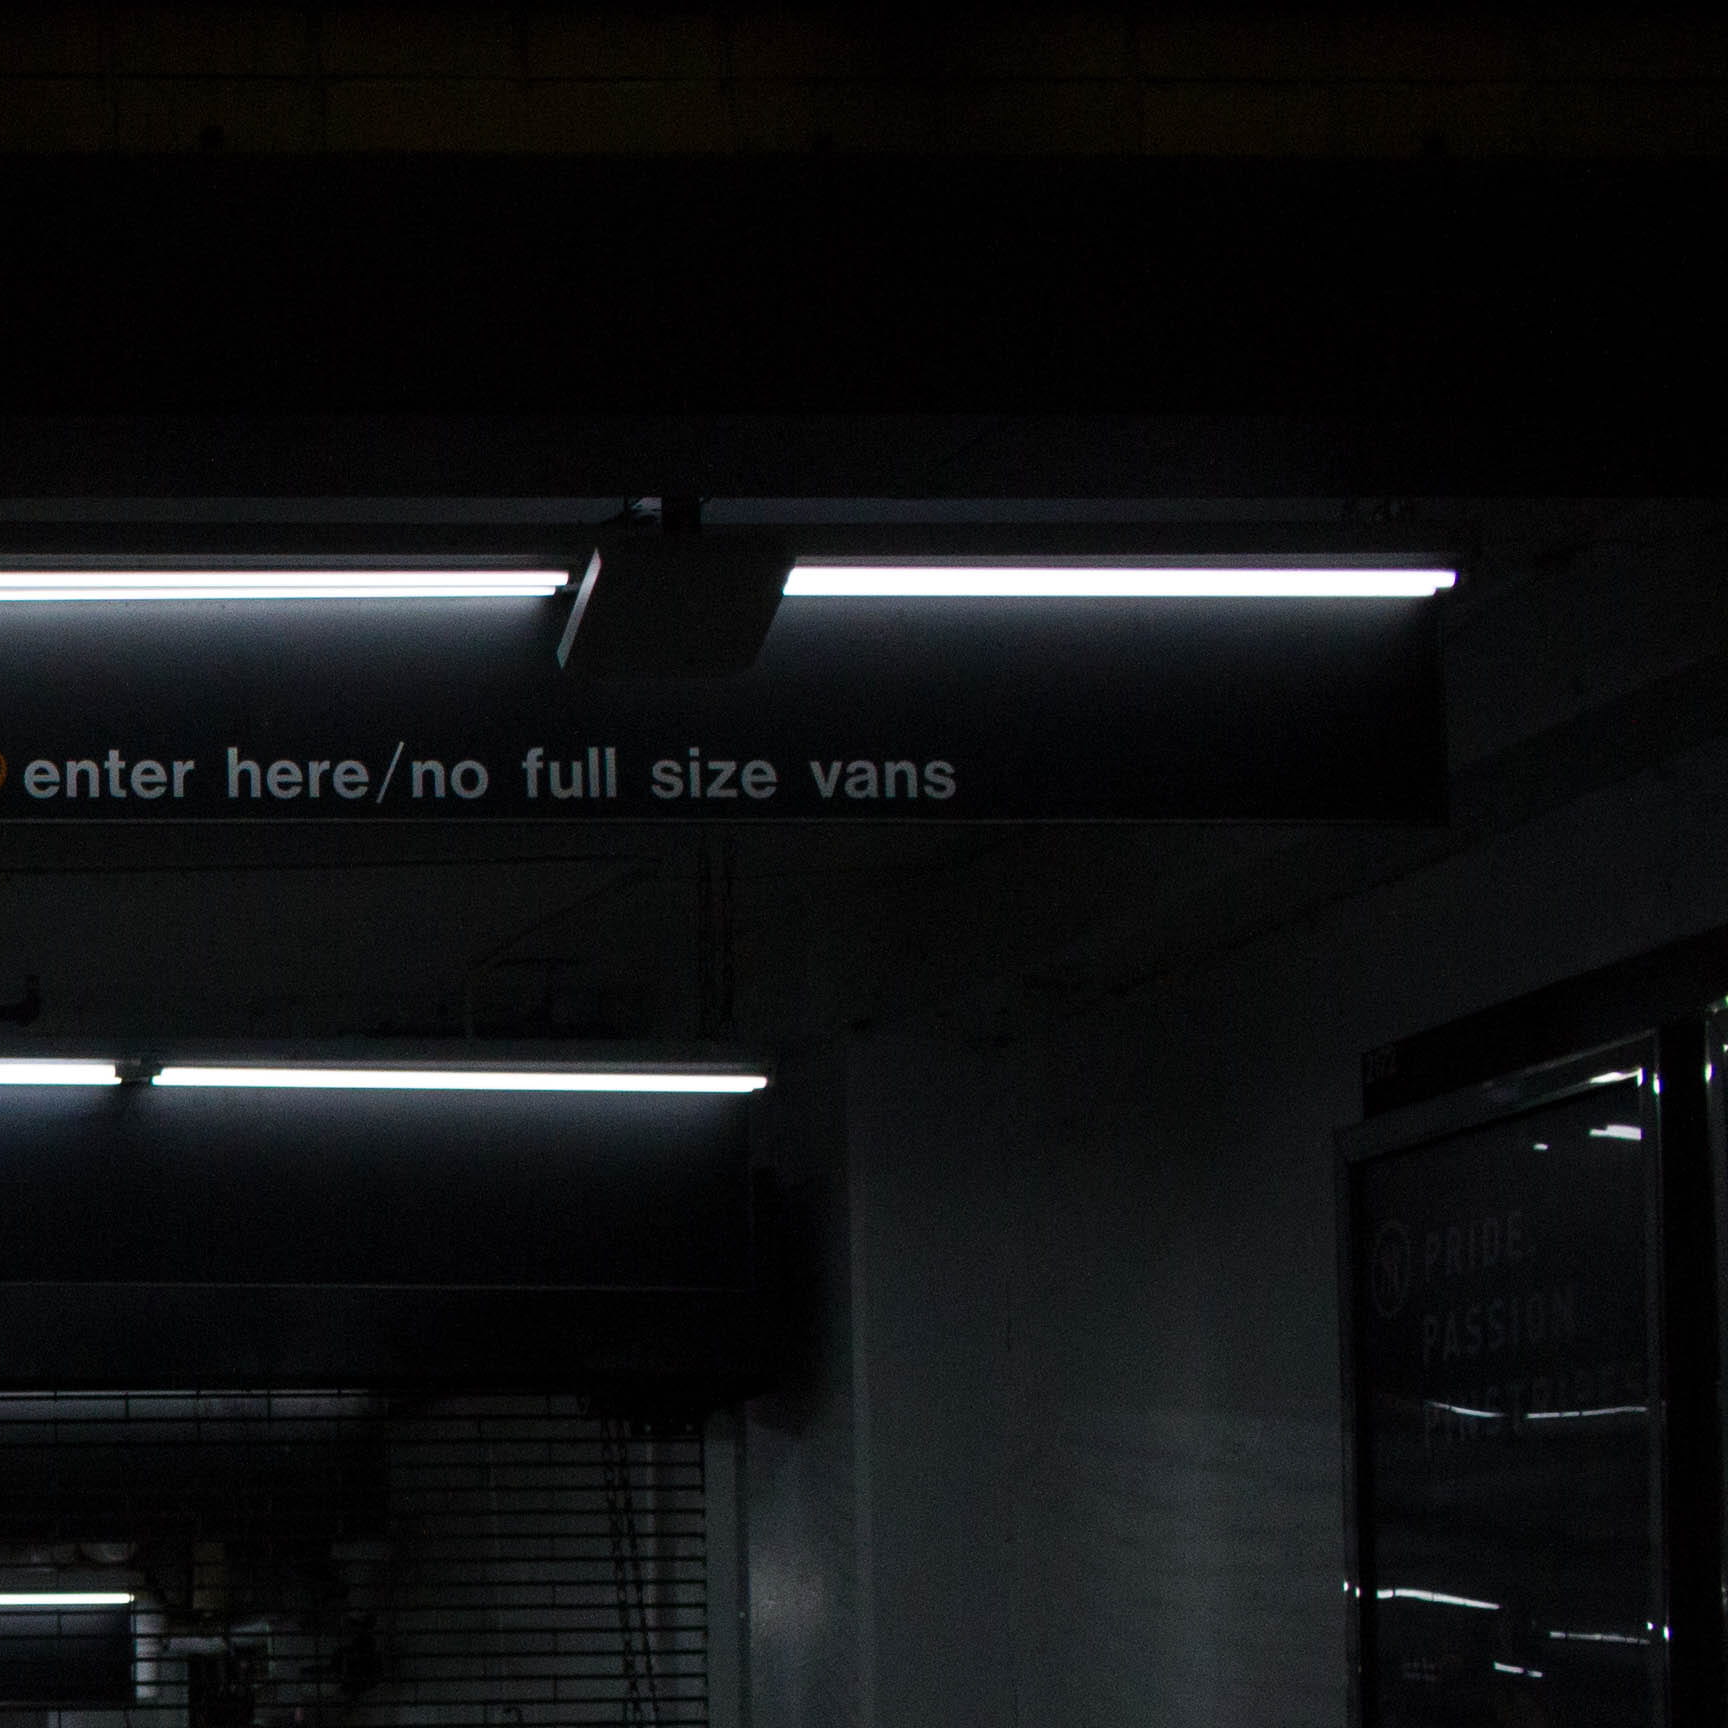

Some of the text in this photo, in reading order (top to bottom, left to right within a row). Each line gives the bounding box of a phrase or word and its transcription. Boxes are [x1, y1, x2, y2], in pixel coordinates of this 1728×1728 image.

[23, 747, 196, 800] enter
[521, 746, 619, 800] full
[650, 747, 779, 800] size
[808, 758, 958, 800] vans
